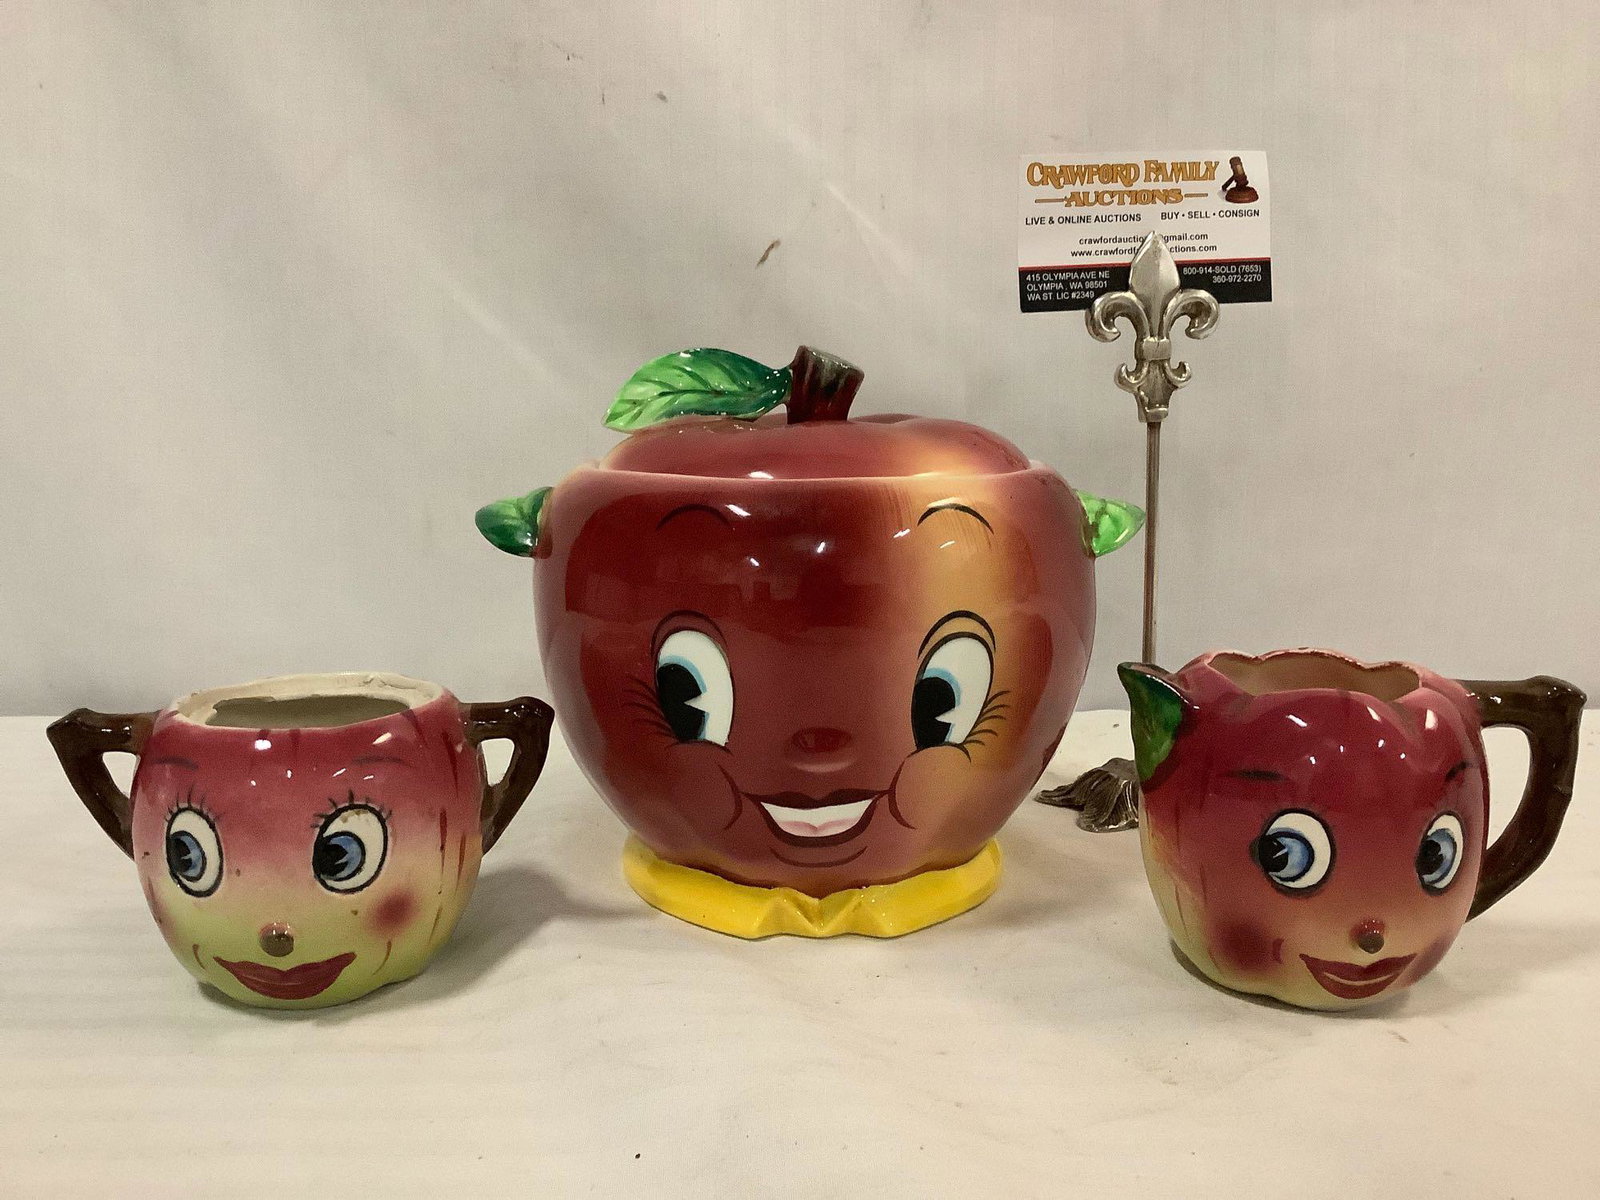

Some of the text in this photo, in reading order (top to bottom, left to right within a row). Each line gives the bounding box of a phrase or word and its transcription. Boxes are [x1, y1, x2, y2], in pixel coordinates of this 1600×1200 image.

[1065, 188, 1183, 207] AUCTIONS
[1025, 213, 1142, 225] LIVE & ONLINE AUCTIONS
[1160, 209, 1260, 220] BUY SELL CONSIGN
[1183, 264, 1262, 275] 800-914-SOLD (7653)
[1042, 272, 1079, 281] OLYMPIA
[1080, 271, 1096, 279] AVE
[1098, 271, 1110, 279] NE
[1212, 273, 1262, 283] 360-972-2270
[1069, 281, 1083, 290] WA
[1085, 280, 1108, 289] 98501
[1027, 293, 1041, 301] WA
[1056, 291, 1070, 300] LIC
[1071, 290, 1095, 299] #2349
